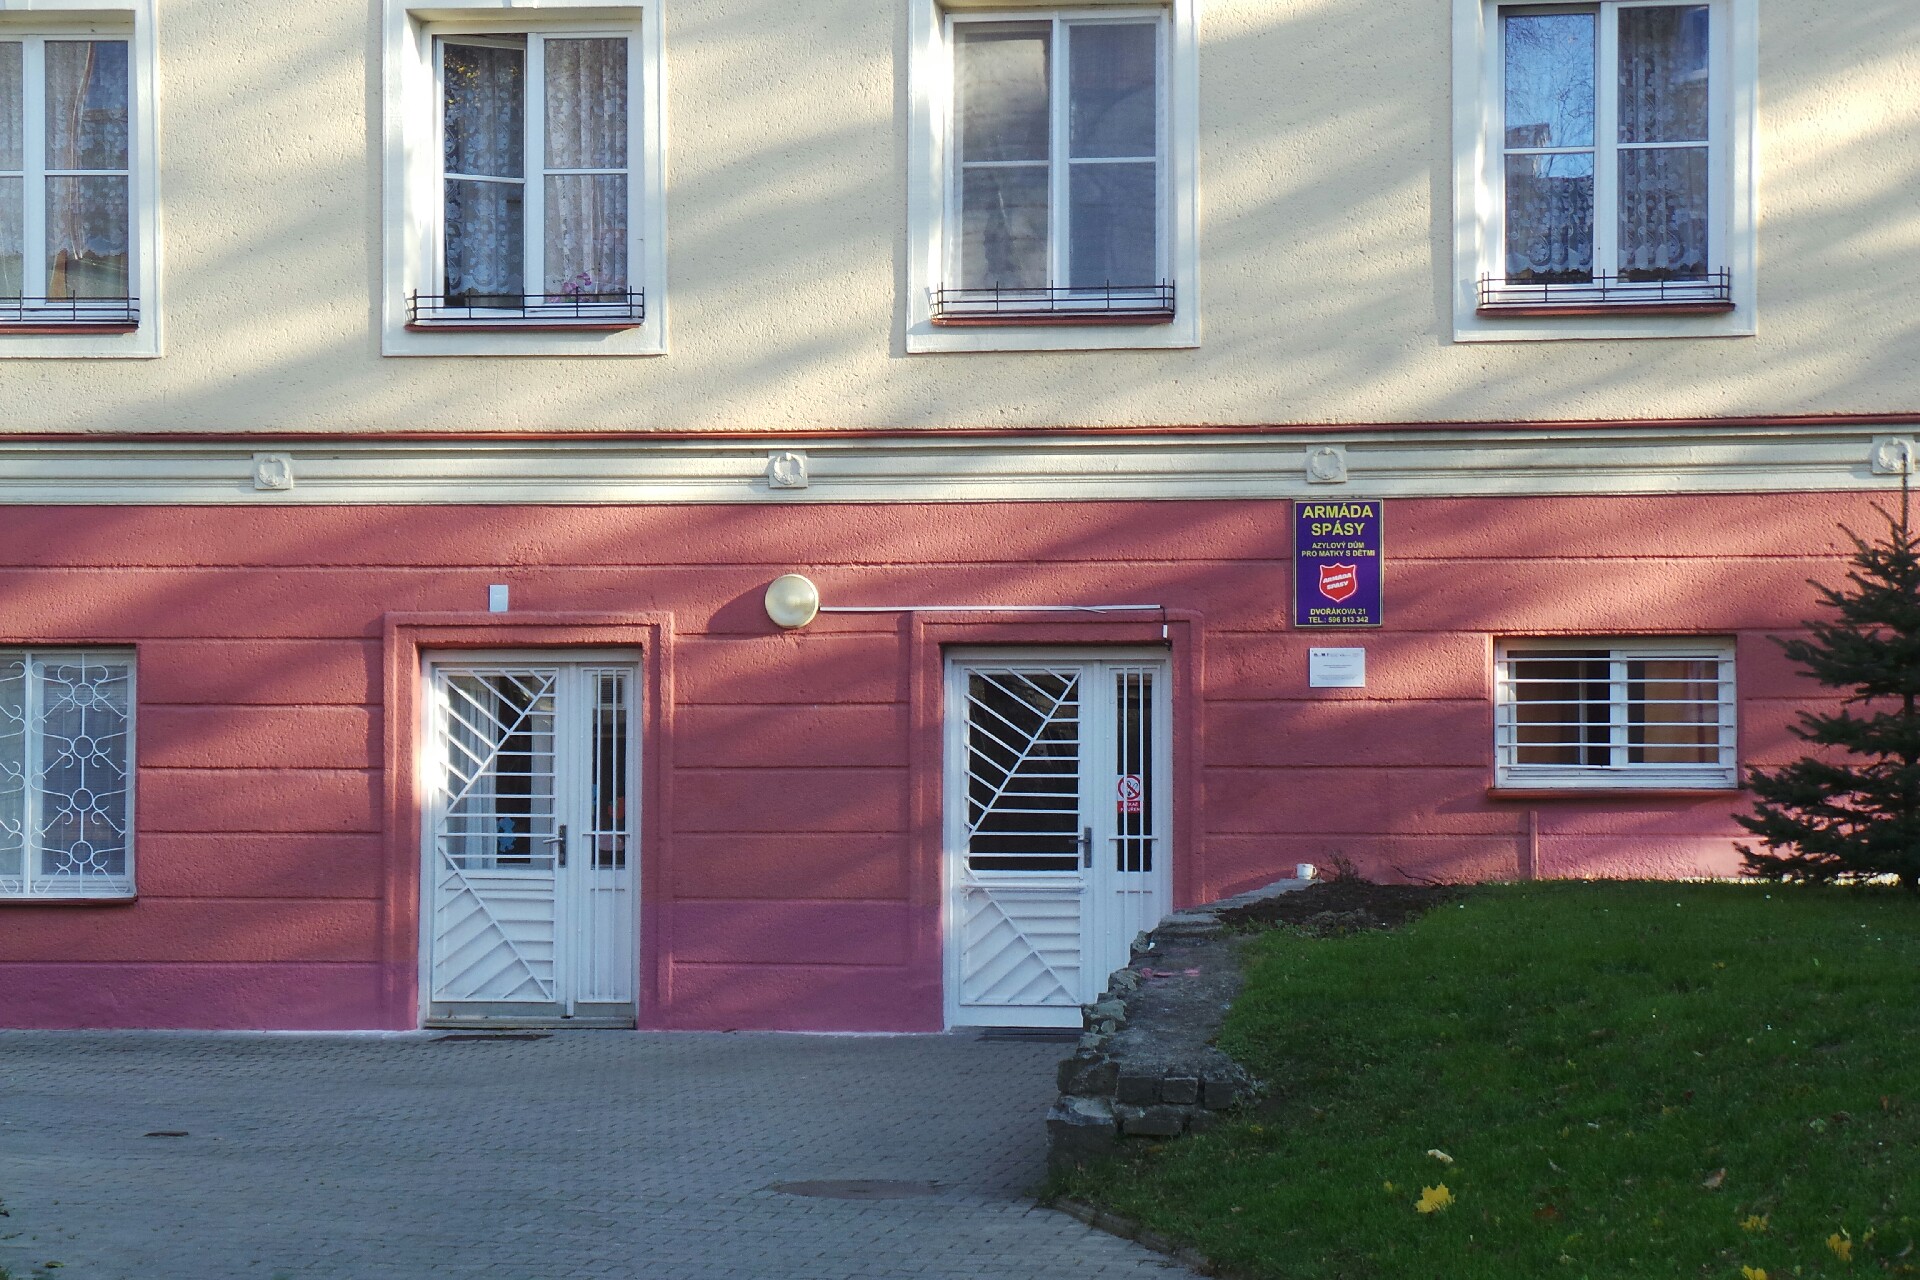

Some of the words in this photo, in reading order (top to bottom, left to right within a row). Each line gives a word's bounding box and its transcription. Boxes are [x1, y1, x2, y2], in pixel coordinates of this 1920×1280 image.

[1302, 503, 1373, 518] ARMÁDA
[1311, 520, 1365, 536] SPÁSY
[1312, 541, 1346, 549] AZYLOVÝ
[1347, 541, 1364, 549] DŮM
[1352, 549, 1375, 557] DĚTMI
[1310, 607, 1356, 615] DVOŘÁKOVA
